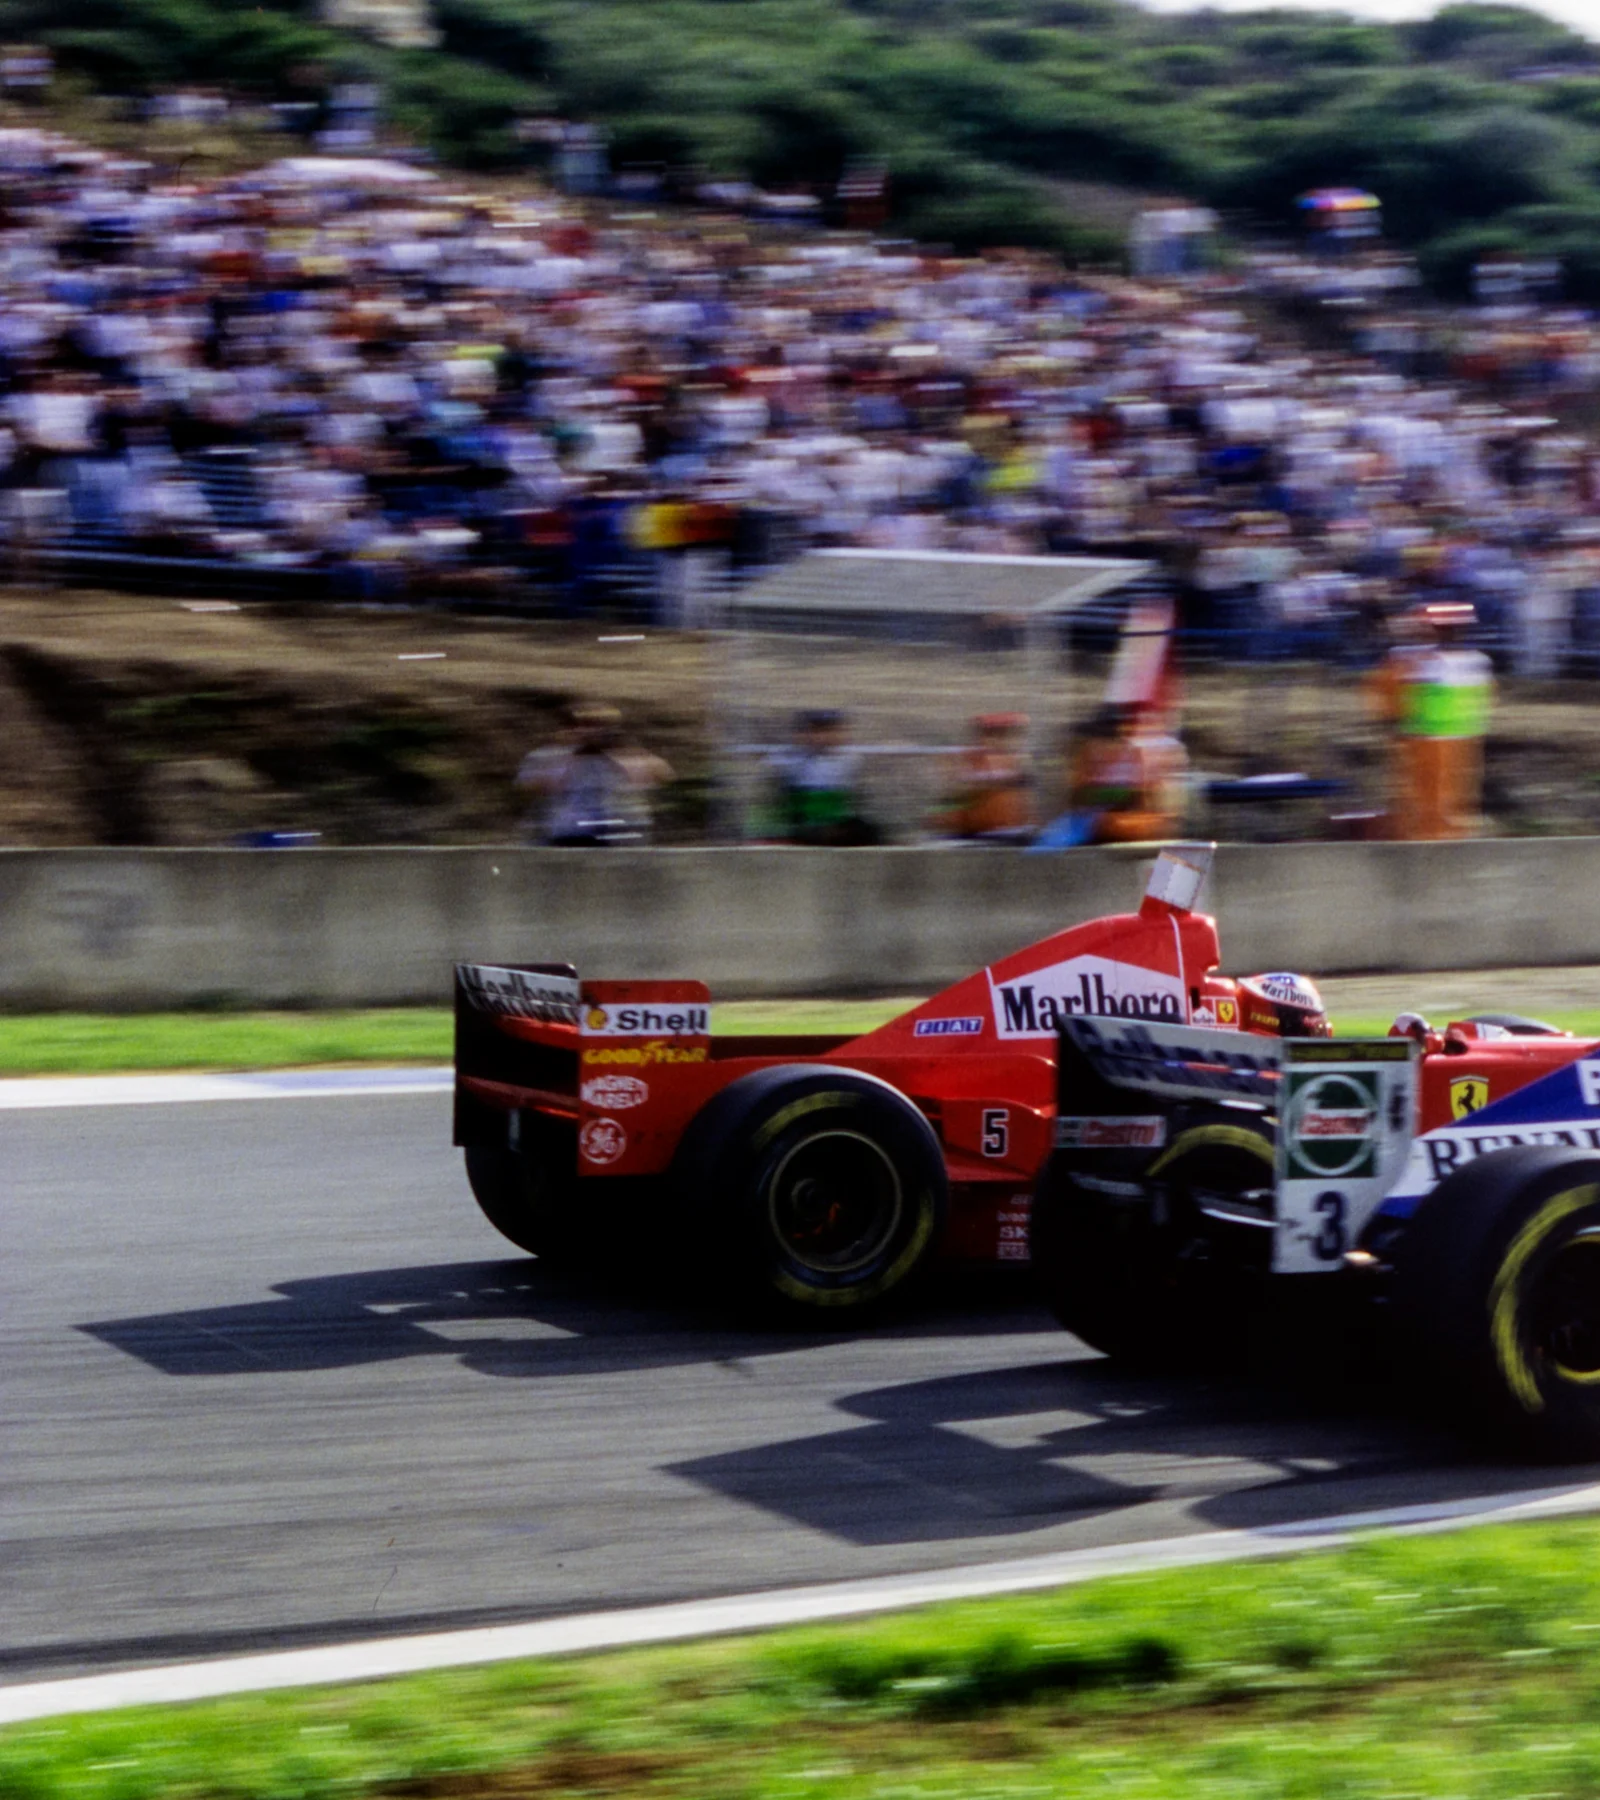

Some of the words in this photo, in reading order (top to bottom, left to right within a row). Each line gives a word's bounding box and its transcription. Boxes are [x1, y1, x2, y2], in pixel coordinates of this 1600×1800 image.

[616, 1009, 706, 1032] Shell
[999, 973, 1182, 1033] Marlboro
[915, 1018, 982, 1036] FIAT
[582, 1041, 706, 1067] GOODYEAR
[982, 1109, 1009, 1157] 5
[1313, 1191, 1347, 1262] 3
